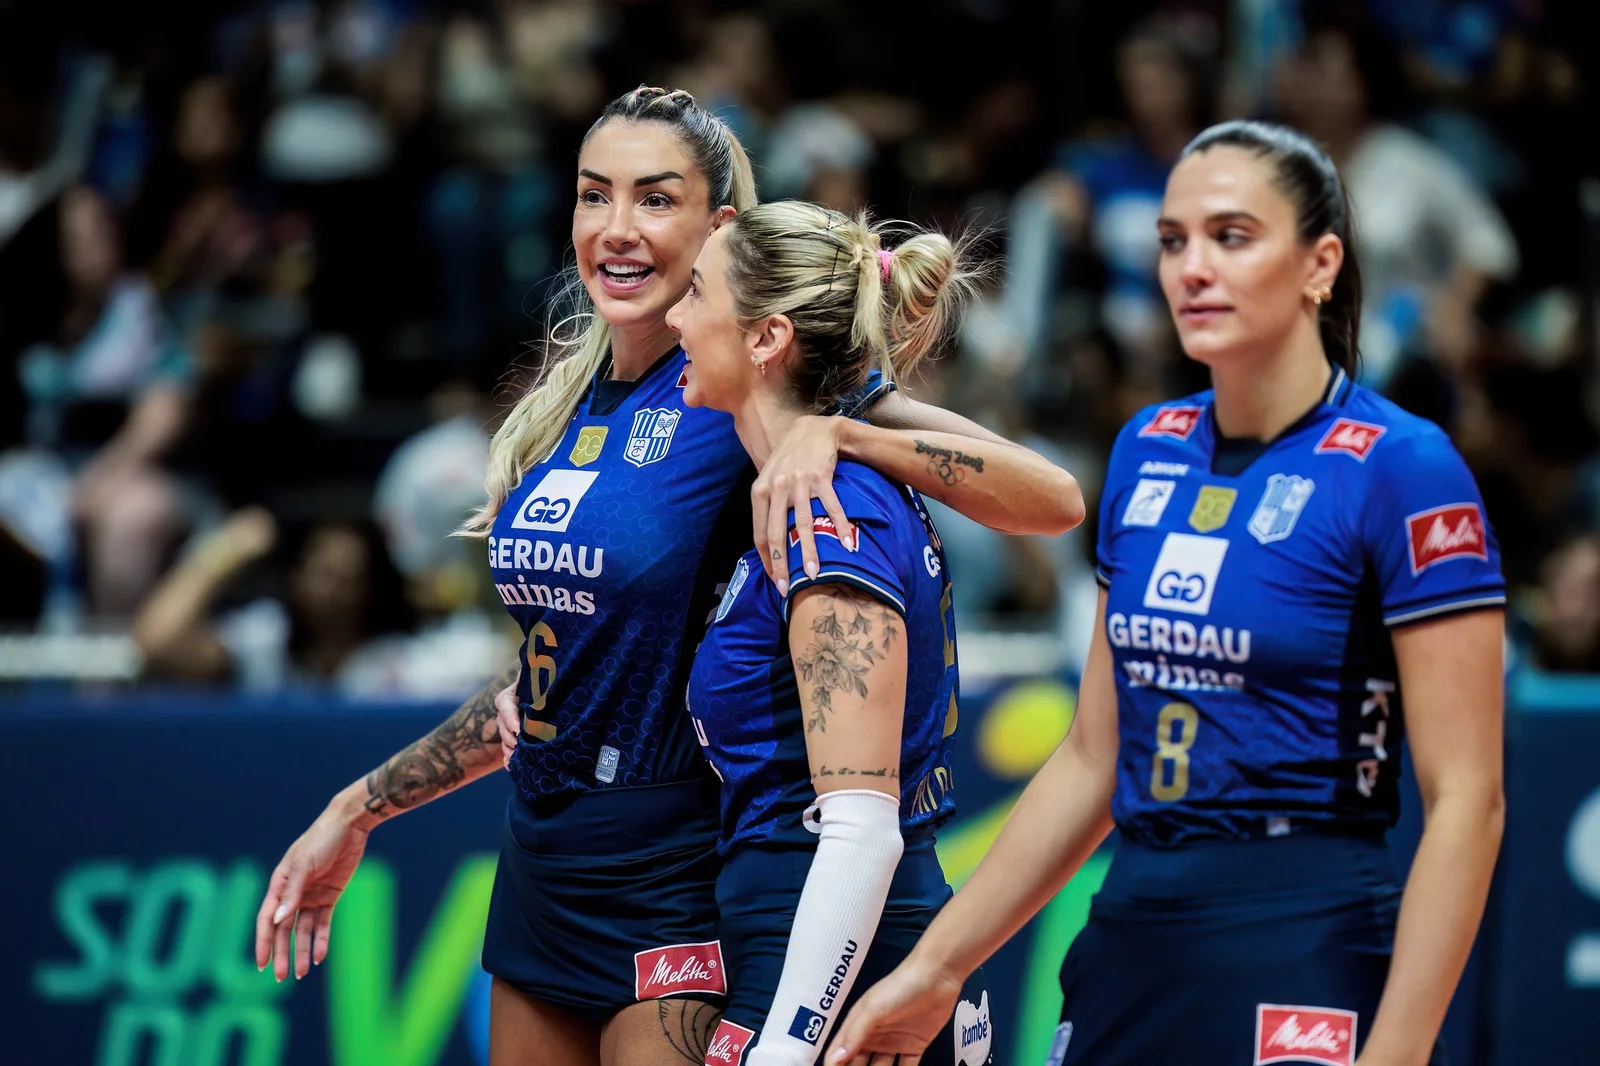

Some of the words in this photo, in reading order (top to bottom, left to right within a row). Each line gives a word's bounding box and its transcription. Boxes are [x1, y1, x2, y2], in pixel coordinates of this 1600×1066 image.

[488, 536, 604, 578] GERDAU
[495, 574, 596, 616] minas
[1108, 612, 1251, 664] GERDAU
[1122, 654, 1245, 692] minas
[1150, 701, 1200, 802] 8
[644, 954, 713, 991] Melitta
[819, 939, 858, 1011] GERDAU
[961, 1013, 988, 1049] itambé
